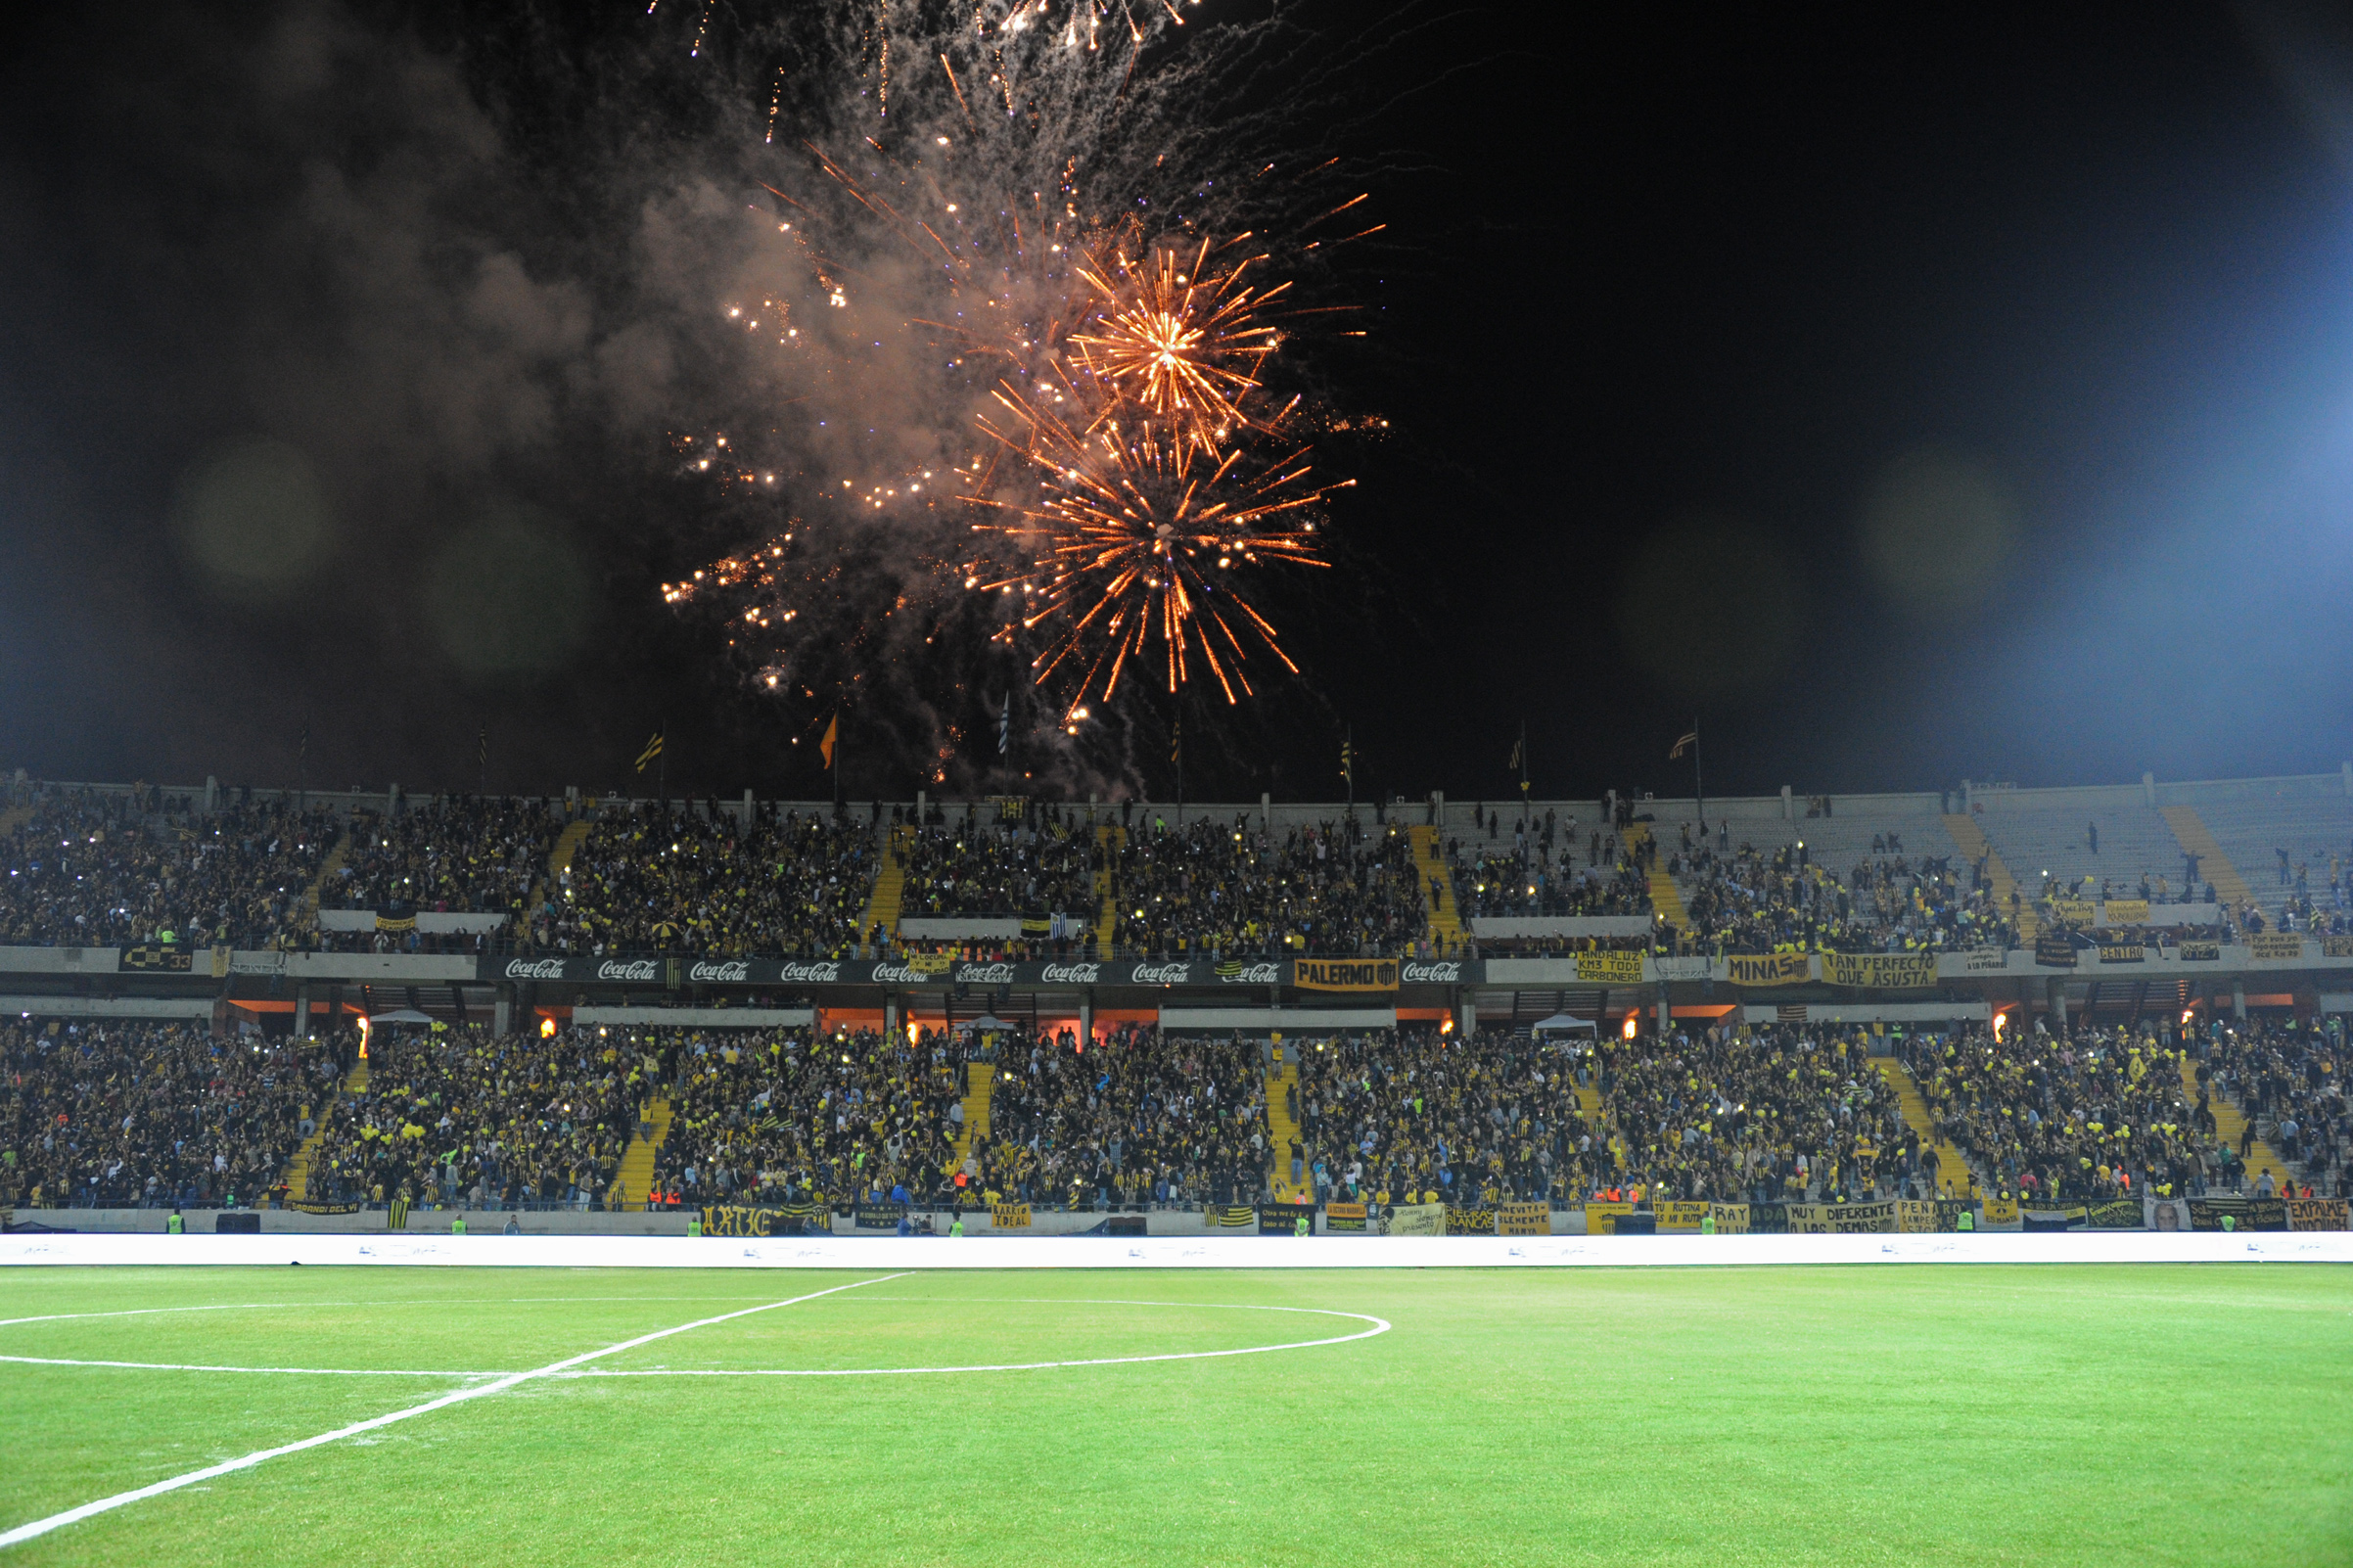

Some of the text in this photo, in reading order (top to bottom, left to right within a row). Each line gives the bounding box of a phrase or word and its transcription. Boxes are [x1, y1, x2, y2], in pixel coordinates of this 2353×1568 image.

[1582, 950, 1639, 962] ANDALUZ
[2099, 946, 2144, 959] CENTRO
[169, 954, 192, 969] 33
[505, 958, 567, 979] Coca-Cola
[1578, 960, 1640, 972] KM3 TODO
[1730, 955, 1794, 981] MINAS
[1825, 953, 1934, 971] TAN PERFECTO
[598, 959, 659, 980] Coca-Cola
[690, 961, 751, 981] Coca-Cola
[781, 962, 841, 983] Coca-Cola
[1041, 962, 1101, 983] Coca-Cola
[1131, 963, 1191, 983] Coca-Cola
[1222, 962, 1281, 983] a-Cola
[1298, 962, 1374, 986] PALERMO
[1402, 962, 1461, 982] Coca-Cola
[1577, 970, 1642, 983] CARBONERO
[1837, 970, 1929, 987] QUE ASUSTA
[328, 1205, 346, 1214] DEL
[993, 1204, 1027, 1216] BARRIO
[1446, 1205, 1495, 1219] PIEDRAS
[1654, 1203, 1700, 1212] TU RUTINA
[1791, 1203, 1894, 1221] MUY DIFERENTE
[1901, 1201, 1962, 1215] PEÑARO
[2289, 1200, 2349, 1218] EMPALME
[995, 1215, 1027, 1226] IDEAL
[1446, 1215, 1495, 1229] BLANCAS
[1499, 1215, 1547, 1224] BLEMENTE
[1655, 1214, 1703, 1223] ES MI RUTIN
[1508, 1226, 1537, 1235] MANYA
[1790, 1220, 1878, 1233] A LOS DEMAS
